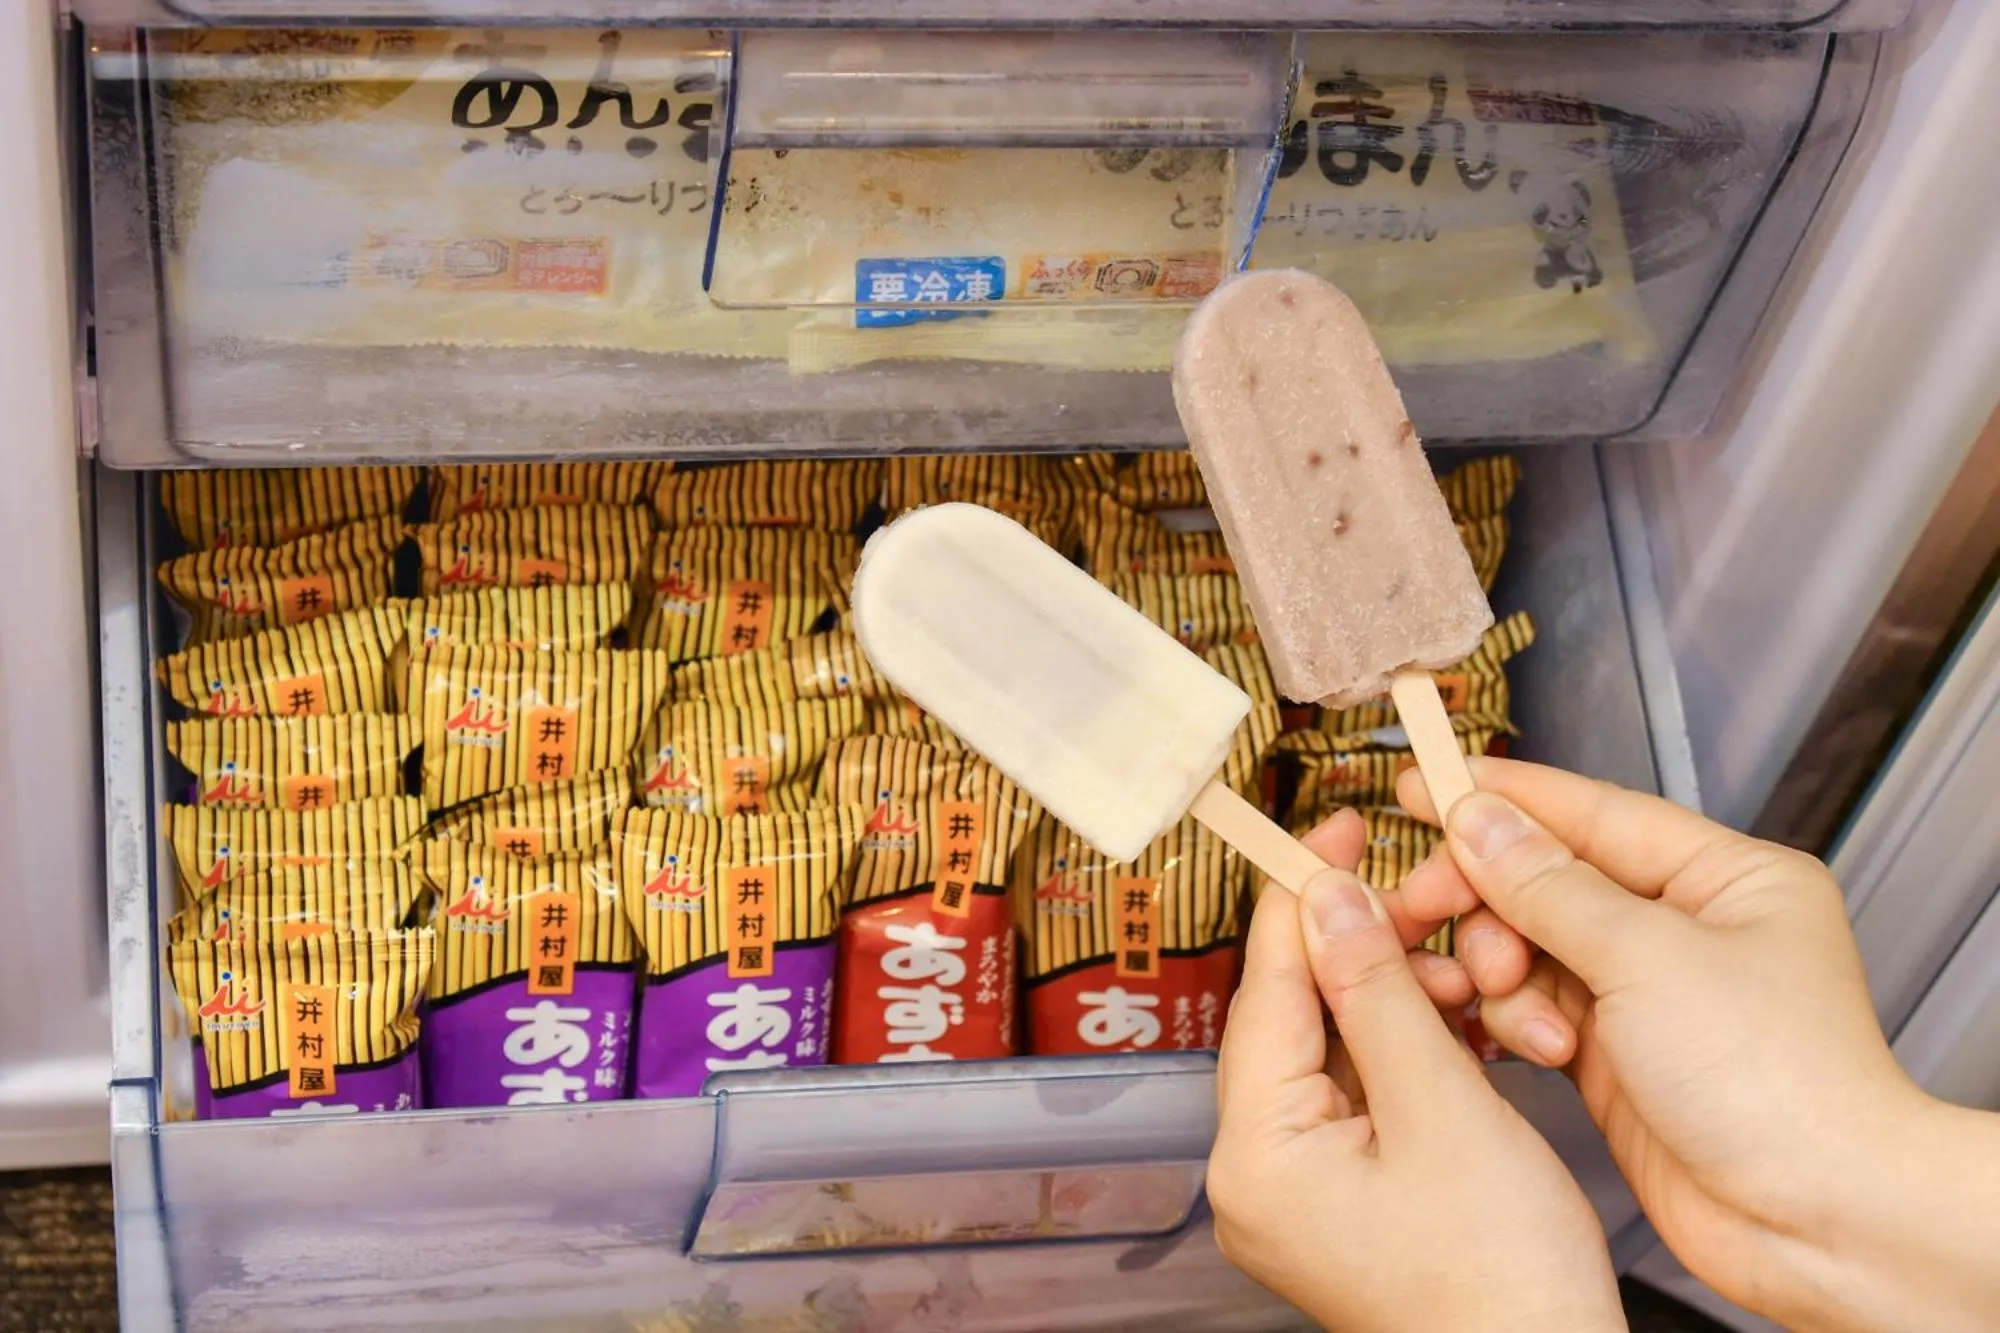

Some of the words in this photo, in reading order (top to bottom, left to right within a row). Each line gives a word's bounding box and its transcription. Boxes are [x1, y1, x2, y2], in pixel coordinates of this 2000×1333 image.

[869, 271, 994, 312] 要冷凍
[289, 688, 315, 712] 井
[537, 717, 565, 777] 井村
[298, 787, 323, 805] 井
[939, 814, 975, 908] 井村屋
[537, 903, 568, 988] 井村屋
[737, 879, 765, 970] 井村屋
[1123, 889, 1150, 972] 井村屋
[704, 983, 792, 1072] あ
[795, 986, 817, 1058] ミルク味
[877, 922, 968, 1063] あず
[297, 999, 327, 1091] 井村屋
[594, 1011, 618, 1088] ミルク味
